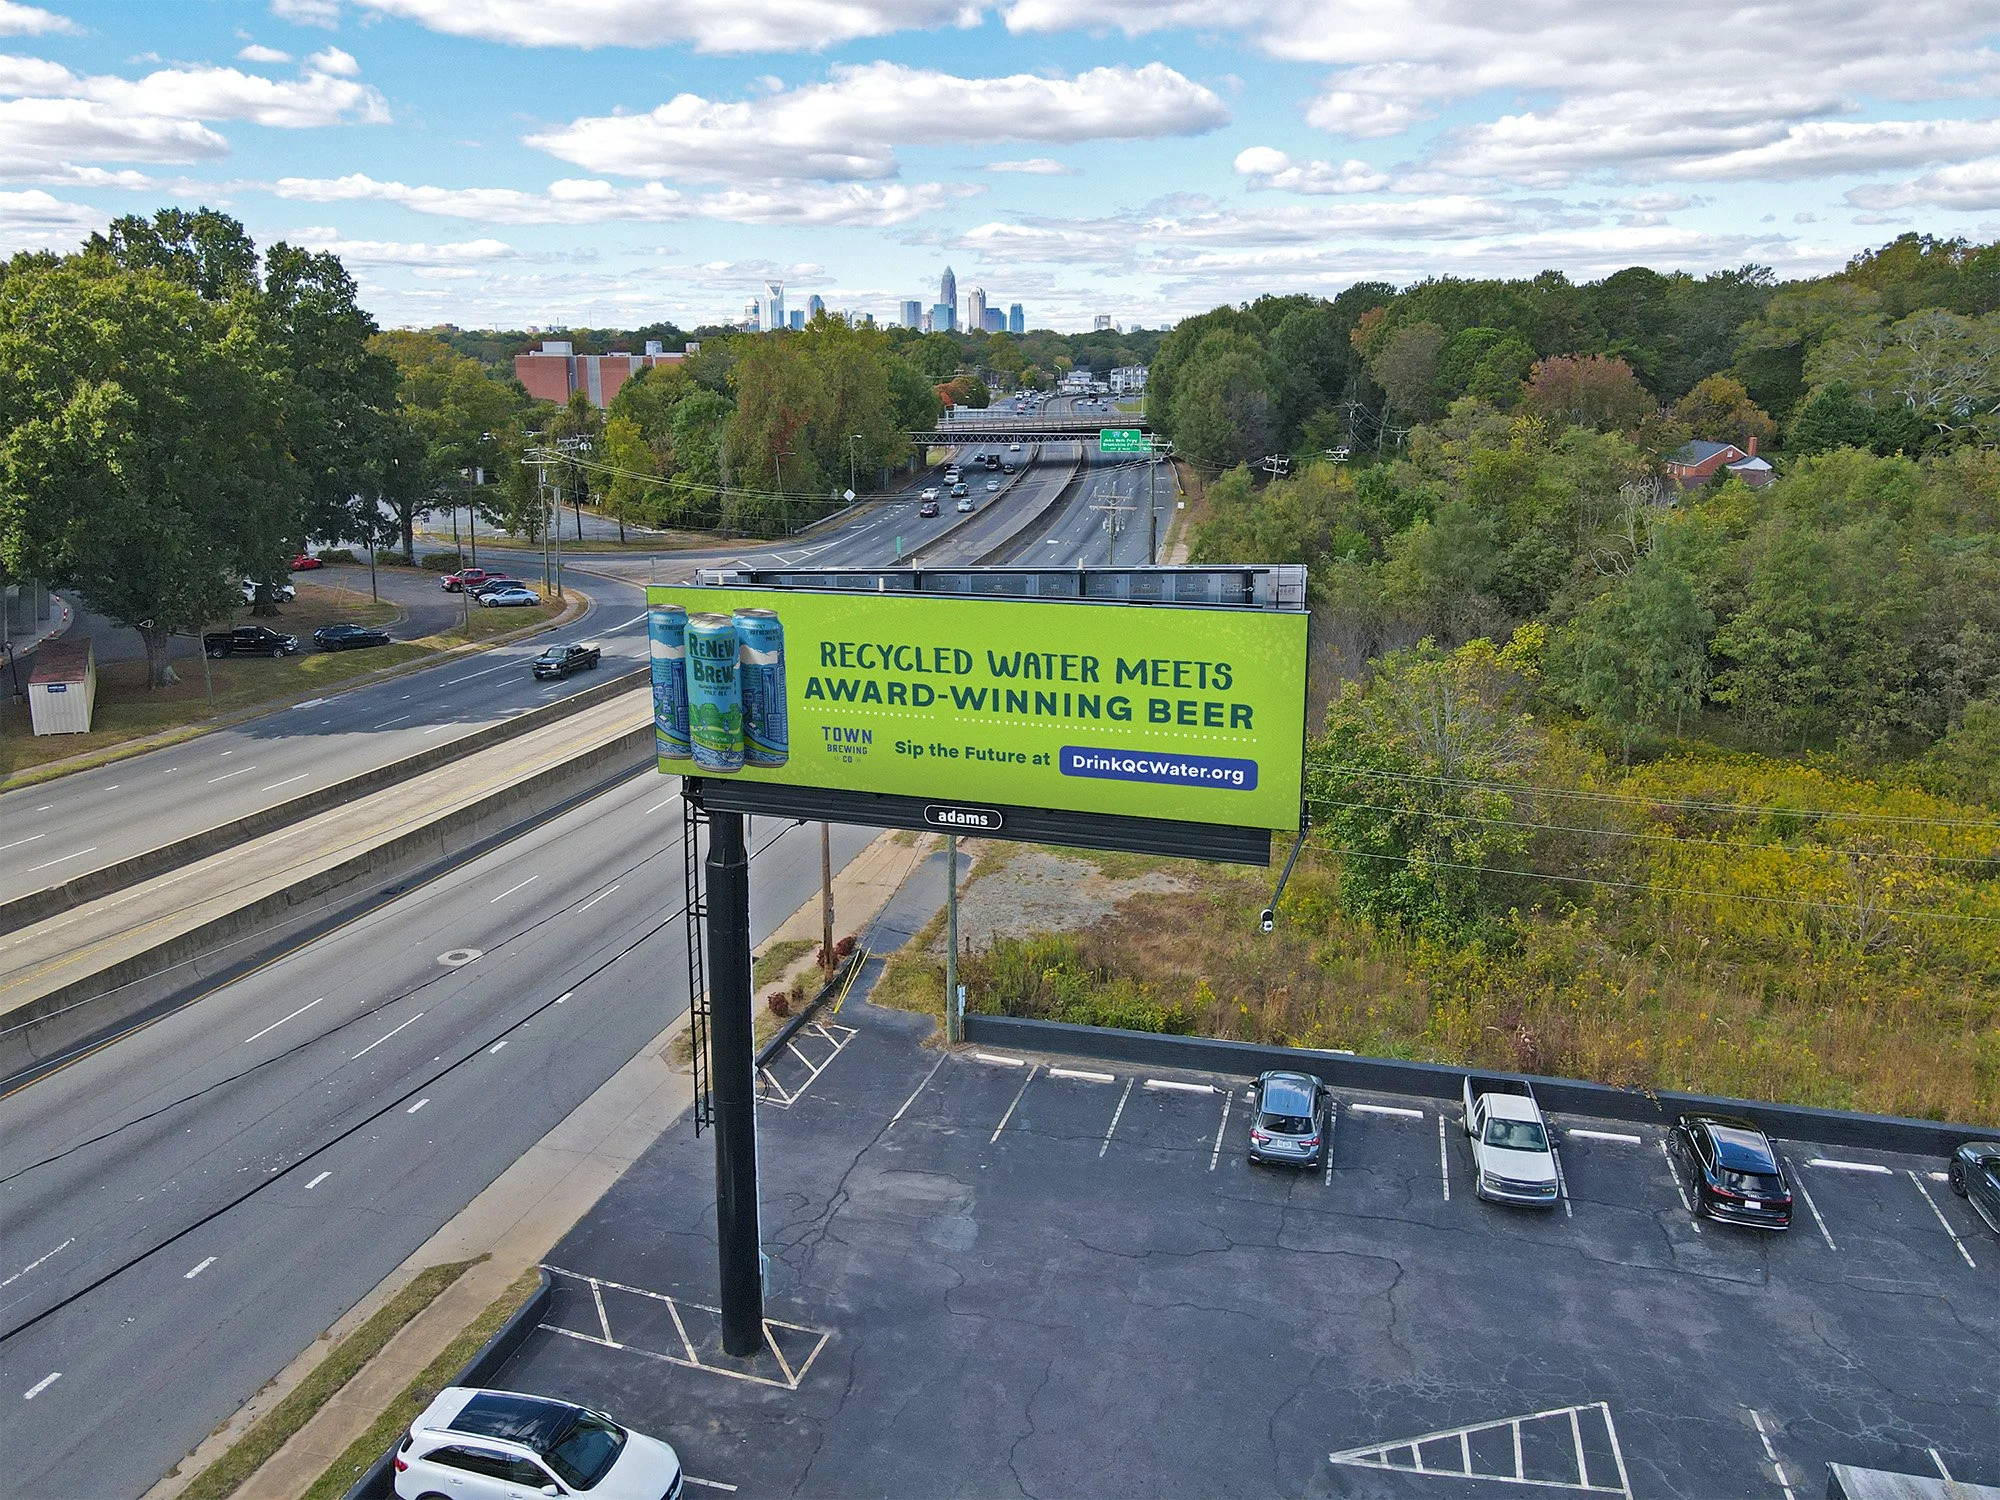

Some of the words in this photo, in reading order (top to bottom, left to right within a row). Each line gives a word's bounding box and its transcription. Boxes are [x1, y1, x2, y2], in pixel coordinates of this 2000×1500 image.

[820, 641, 973, 676] RECYCLED
[986, 649, 1100, 683] WATER
[1115, 657, 1233, 691] MEETS
[804, 676, 1132, 722] AWARD-WINNING
[1148, 698, 1254, 730] BEER
[821, 726, 873, 745] TOWN
[827, 743, 868, 755] BREWING
[842, 755, 853, 764] CO
[894, 740, 924, 760] Sip
[928, 742, 959, 759] the
[965, 746, 1027, 764] Future
[1031, 752, 1051, 766] at
[1073, 755, 1244, 785] DrinkQCWater.org
[938, 809, 988, 826] adams
